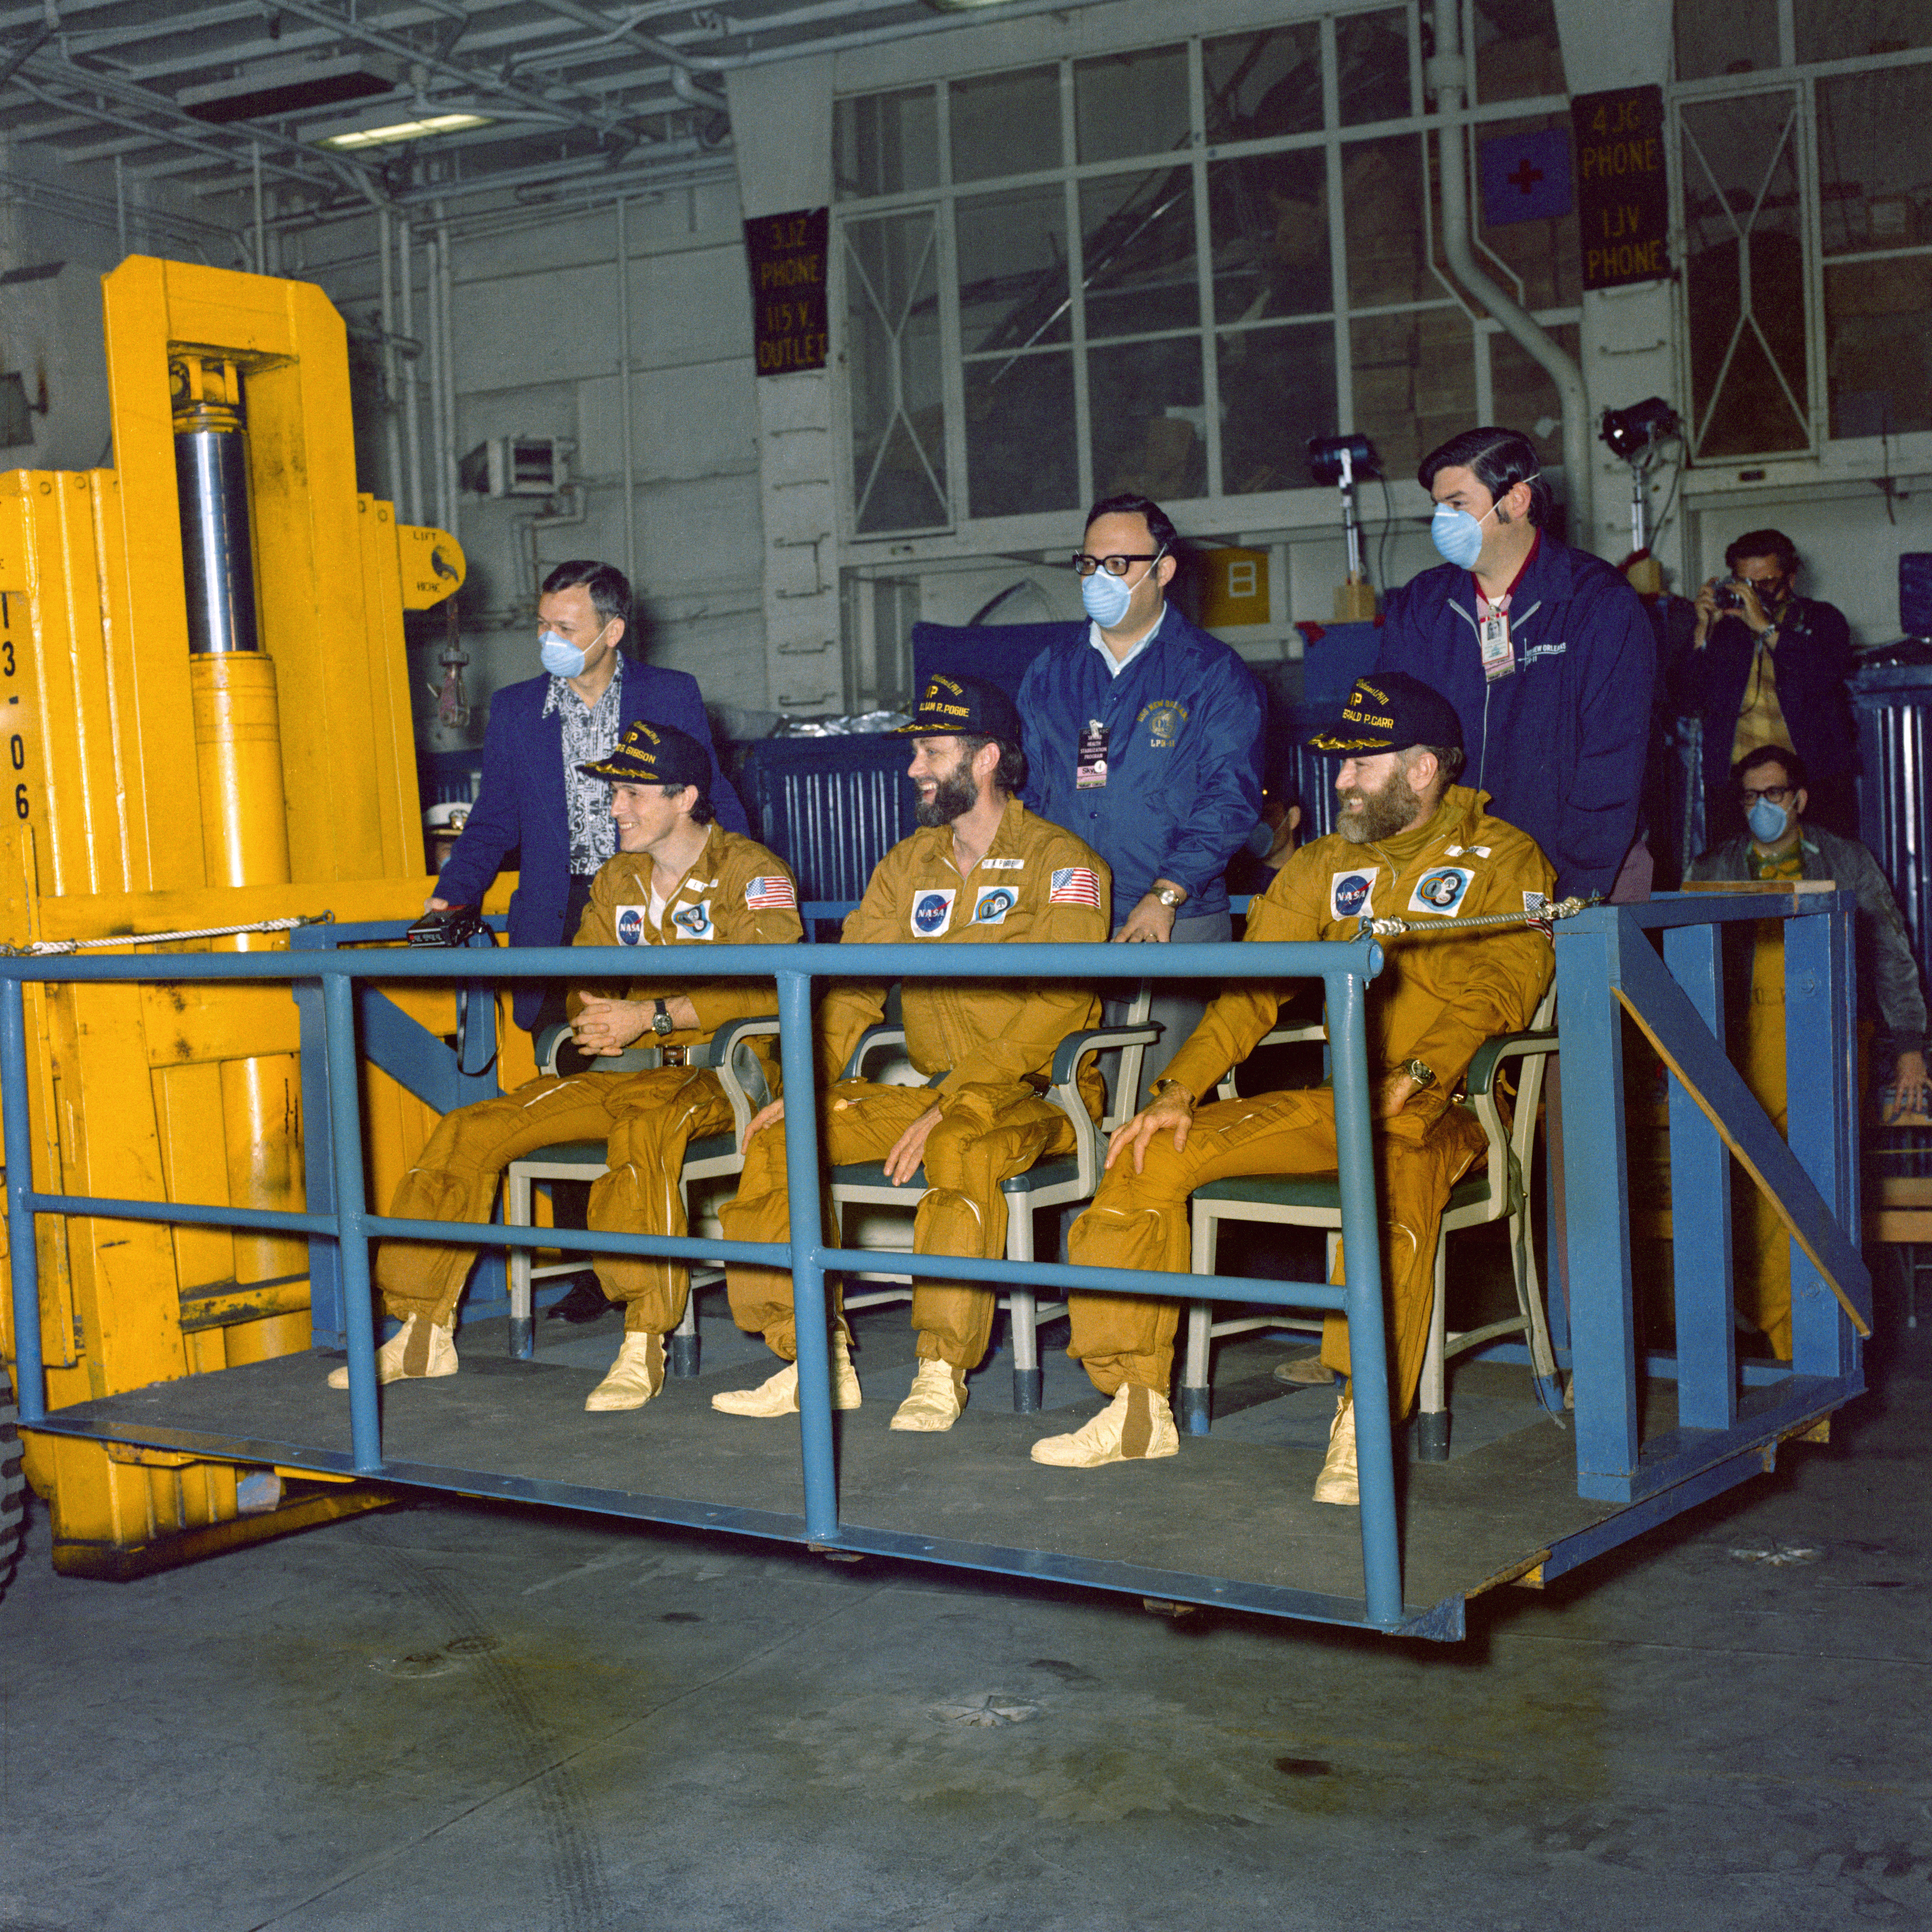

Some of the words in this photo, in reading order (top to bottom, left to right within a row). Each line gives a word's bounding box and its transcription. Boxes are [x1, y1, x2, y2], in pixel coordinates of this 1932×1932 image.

[1583, 138, 1658, 179] PHONE
[1588, 239, 1662, 280] PHONE
[761, 254, 821, 290] PHONE
[767, 303, 792, 334] 115
[758, 332, 826, 368] OUTLET
[413, 531, 436, 542] LIFT
[1543, 642, 1566, 652] ORLEANS
[1147, 699, 1163, 712] NEW
[1165, 700, 1188, 722] ORLEANS
[1150, 739, 1175, 747] LPH-11
[626, 746, 656, 764] GIBSON
[1337, 889, 1365, 902] NASA
[918, 908, 944, 918] NASA
[620, 923, 641, 932] NASA
